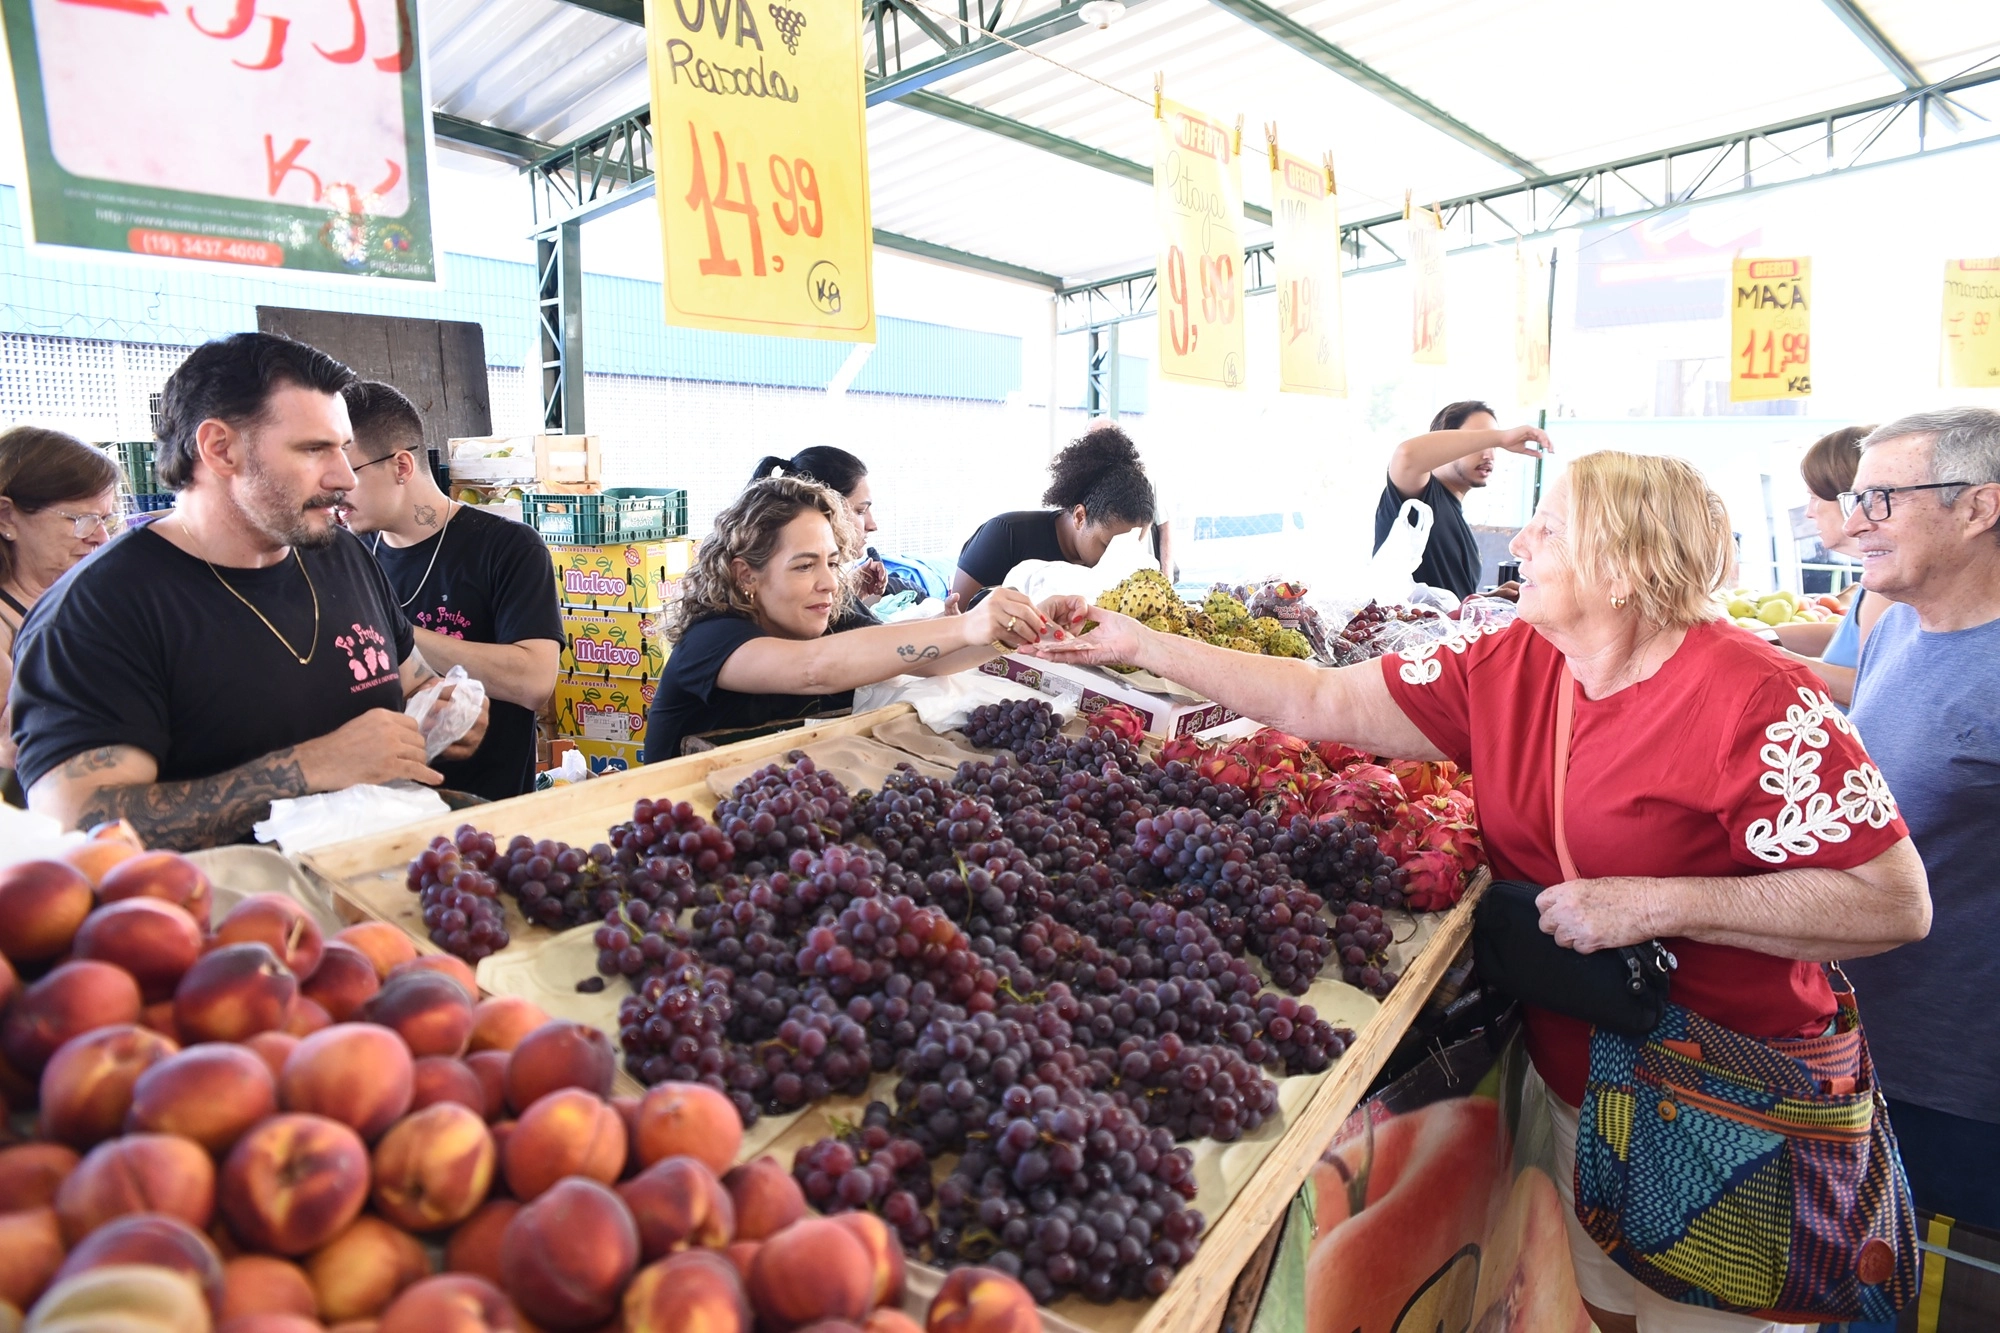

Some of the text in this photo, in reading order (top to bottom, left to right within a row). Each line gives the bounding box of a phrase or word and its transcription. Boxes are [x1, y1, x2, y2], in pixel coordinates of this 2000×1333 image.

[1180, 117, 1226, 162] OFERTA
[685, 121, 823, 277] 14,99
[1288, 161, 1321, 198] OFERTA
[143, 233, 267, 261] (19) 3437-4000
[1168, 245, 1236, 357] 9,99
[1740, 329, 1810, 379] 11,99
[565, 570, 626, 595] Malevo
[576, 640, 640, 666] Malevo
